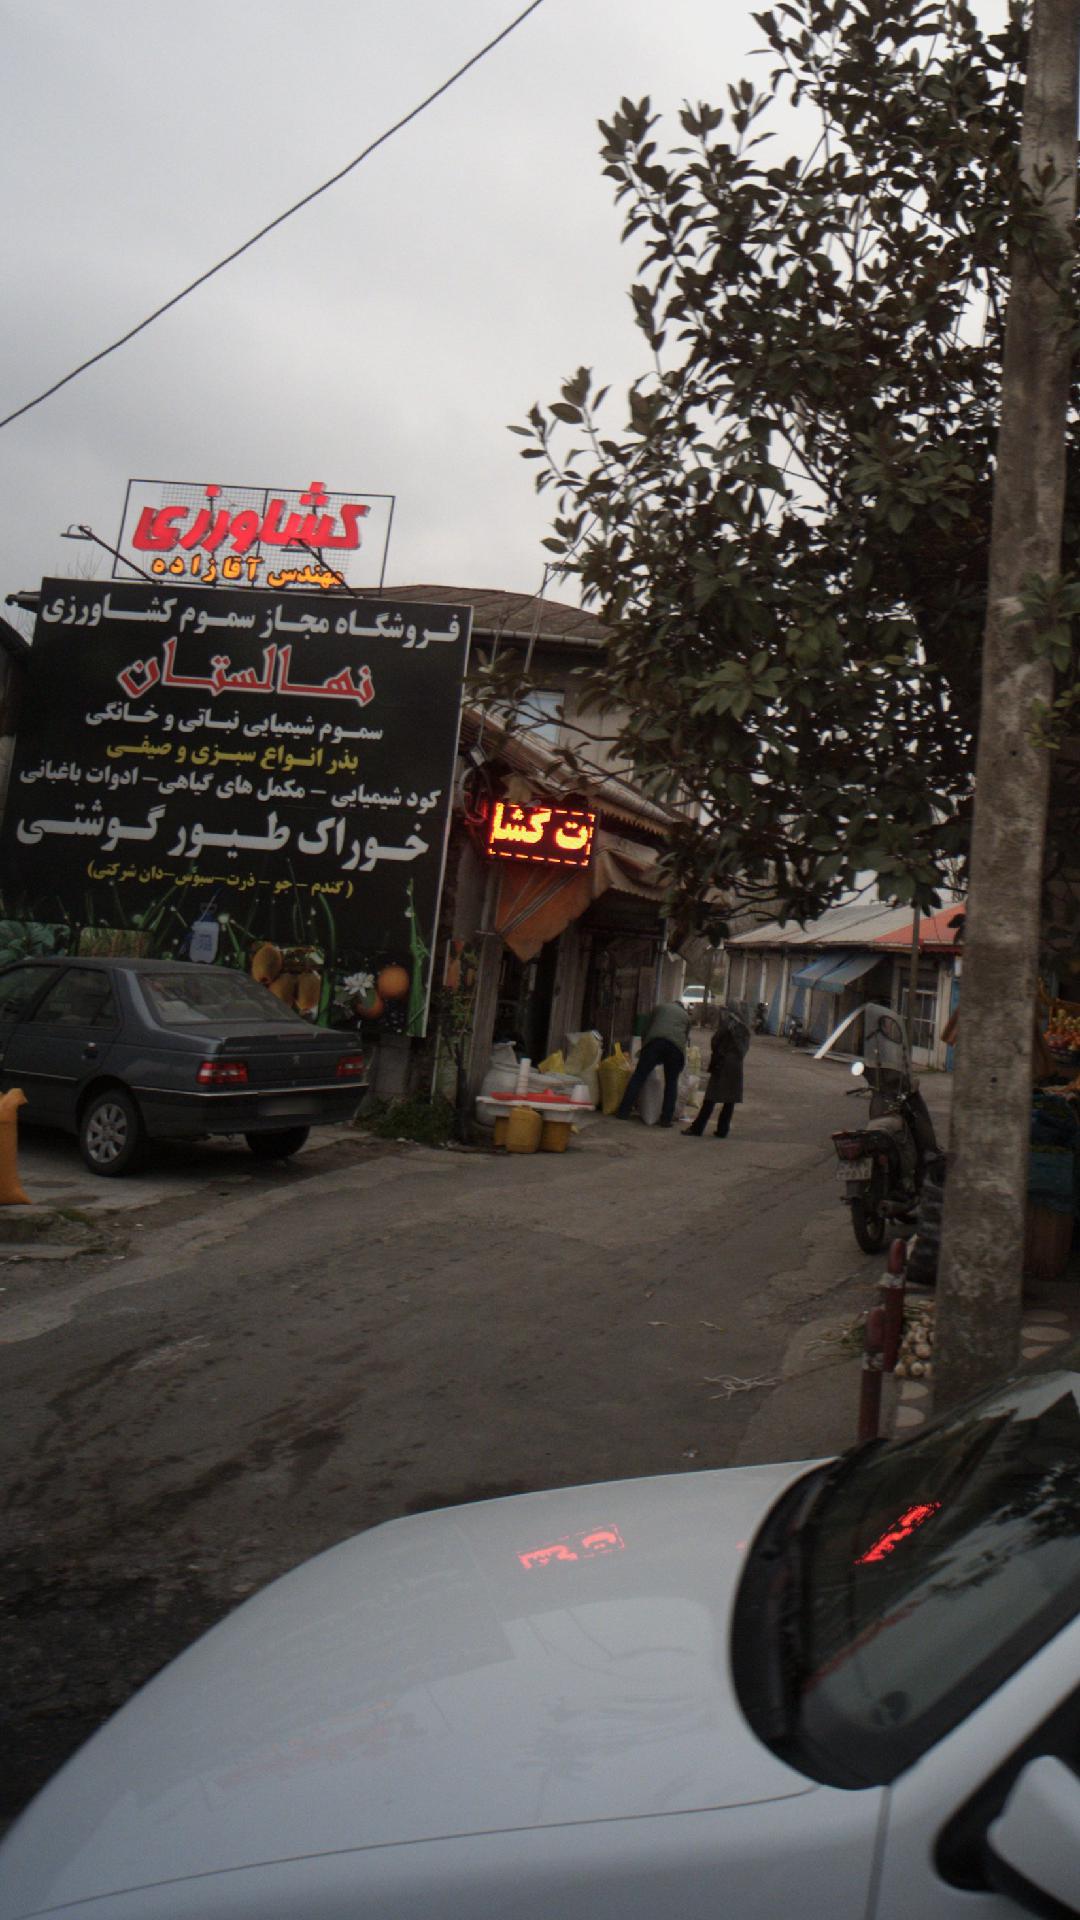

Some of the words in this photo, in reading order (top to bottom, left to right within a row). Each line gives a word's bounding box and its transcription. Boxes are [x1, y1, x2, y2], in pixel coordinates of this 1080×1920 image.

[132, 481, 370, 554] کشاورزی
[268, 563, 345, 588] مهندس
[41, 594, 177, 625] کشاورزی
[179, 605, 255, 633] سموم
[259, 604, 330, 639] مجاز
[335, 609, 460, 648] فروشگاه
[116, 637, 376, 707] نهالستان
[85, 702, 159, 727] خانگی
[162, 712, 175, 732] و
[178, 708, 240, 734] نباتی
[243, 712, 315, 738] شیمیایی
[319, 722, 383, 743] سموم
[106, 734, 171, 758] صیفی
[174, 745, 187, 764] و
[190, 743, 256, 765] سبزی
[260, 746, 324, 772] انواع
[20, 759, 82, 785] باغبانی
[326, 749, 359, 774] بذر
[85, 765, 139, 791] ادوات
[216, 774, 252, 798] های
[256, 776, 305, 801] مکمل
[330, 783, 402, 808] شیمیایی
[405, 790, 441, 814] کود
[16, 799, 166, 851] گوشتی
[168, 811, 291, 858] طیور
[555, 821, 588, 850] ت
[298, 816, 430, 871] خوراک
